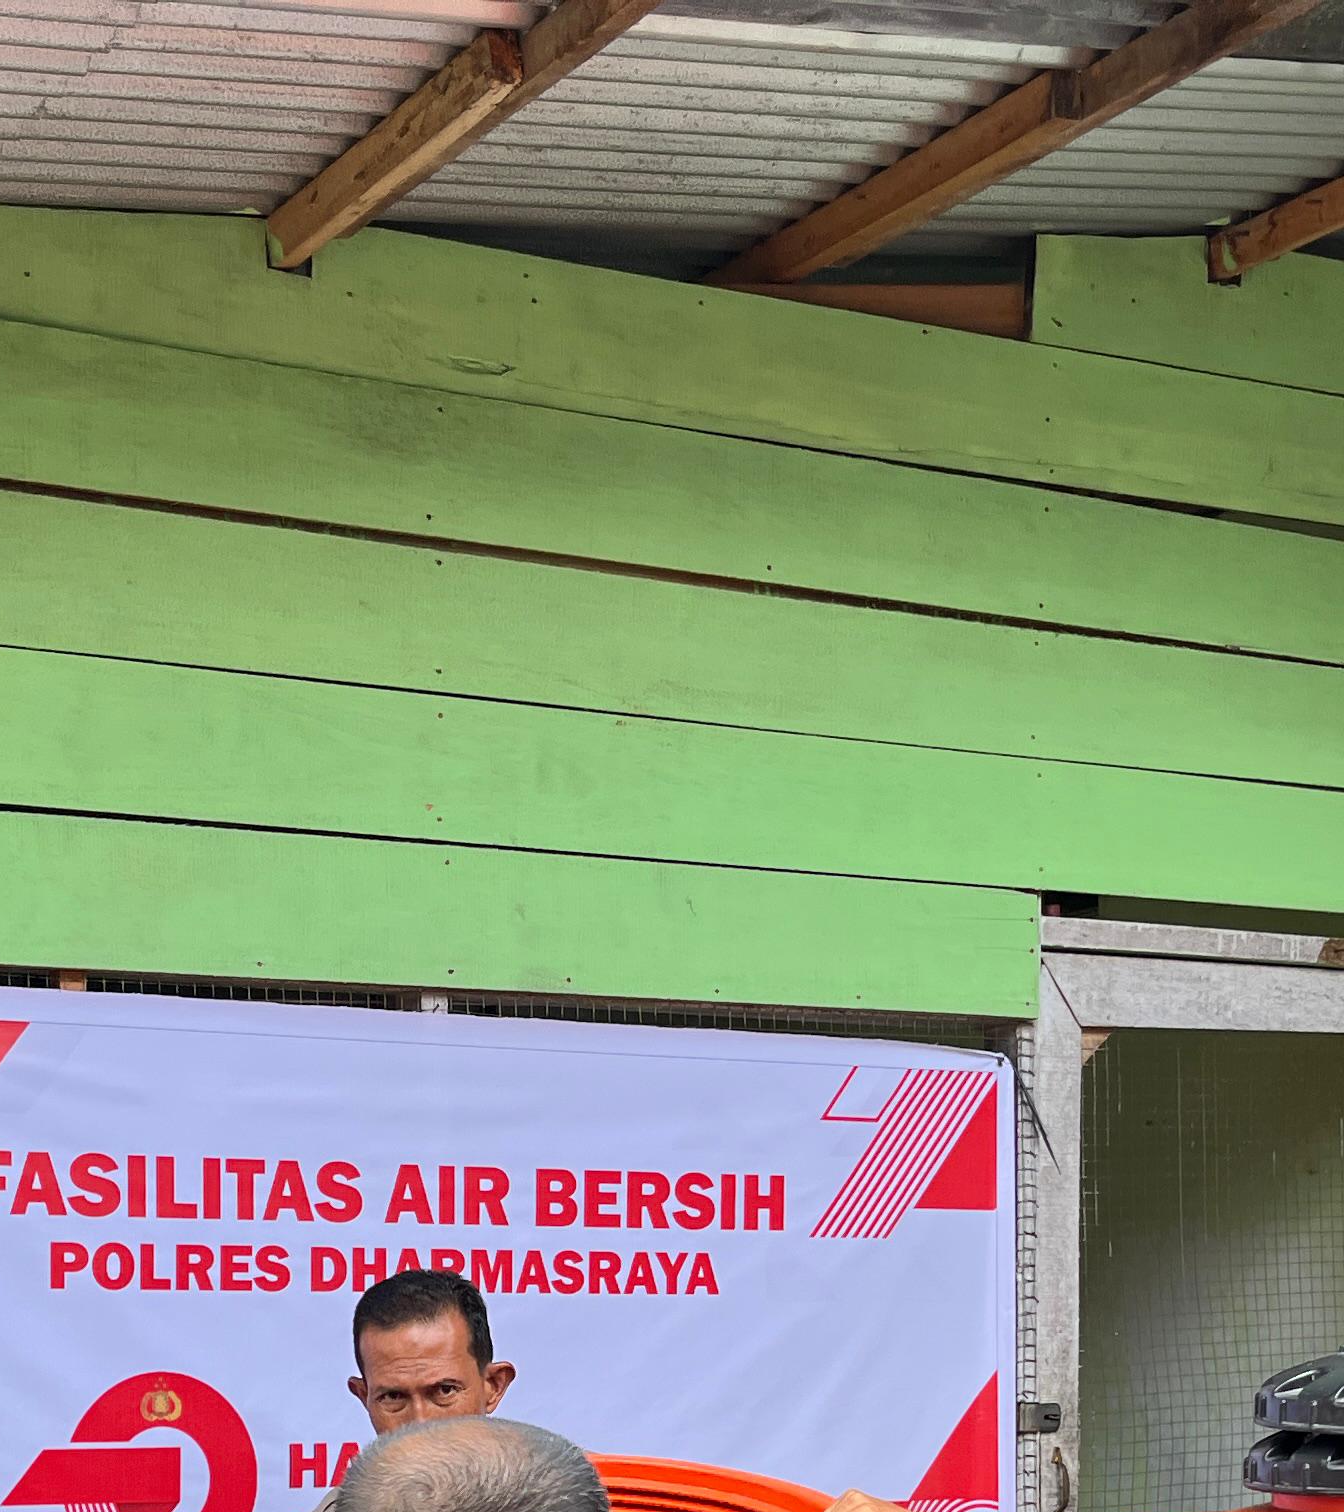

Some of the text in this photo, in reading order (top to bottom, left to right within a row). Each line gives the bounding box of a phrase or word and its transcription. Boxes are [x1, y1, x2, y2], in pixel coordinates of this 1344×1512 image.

[385, 1163, 510, 1226] AIR
[535, 1168, 785, 1231] BERSIH
[50, 1241, 291, 1292] POLRES
[289, 1442, 361, 1489] HA
